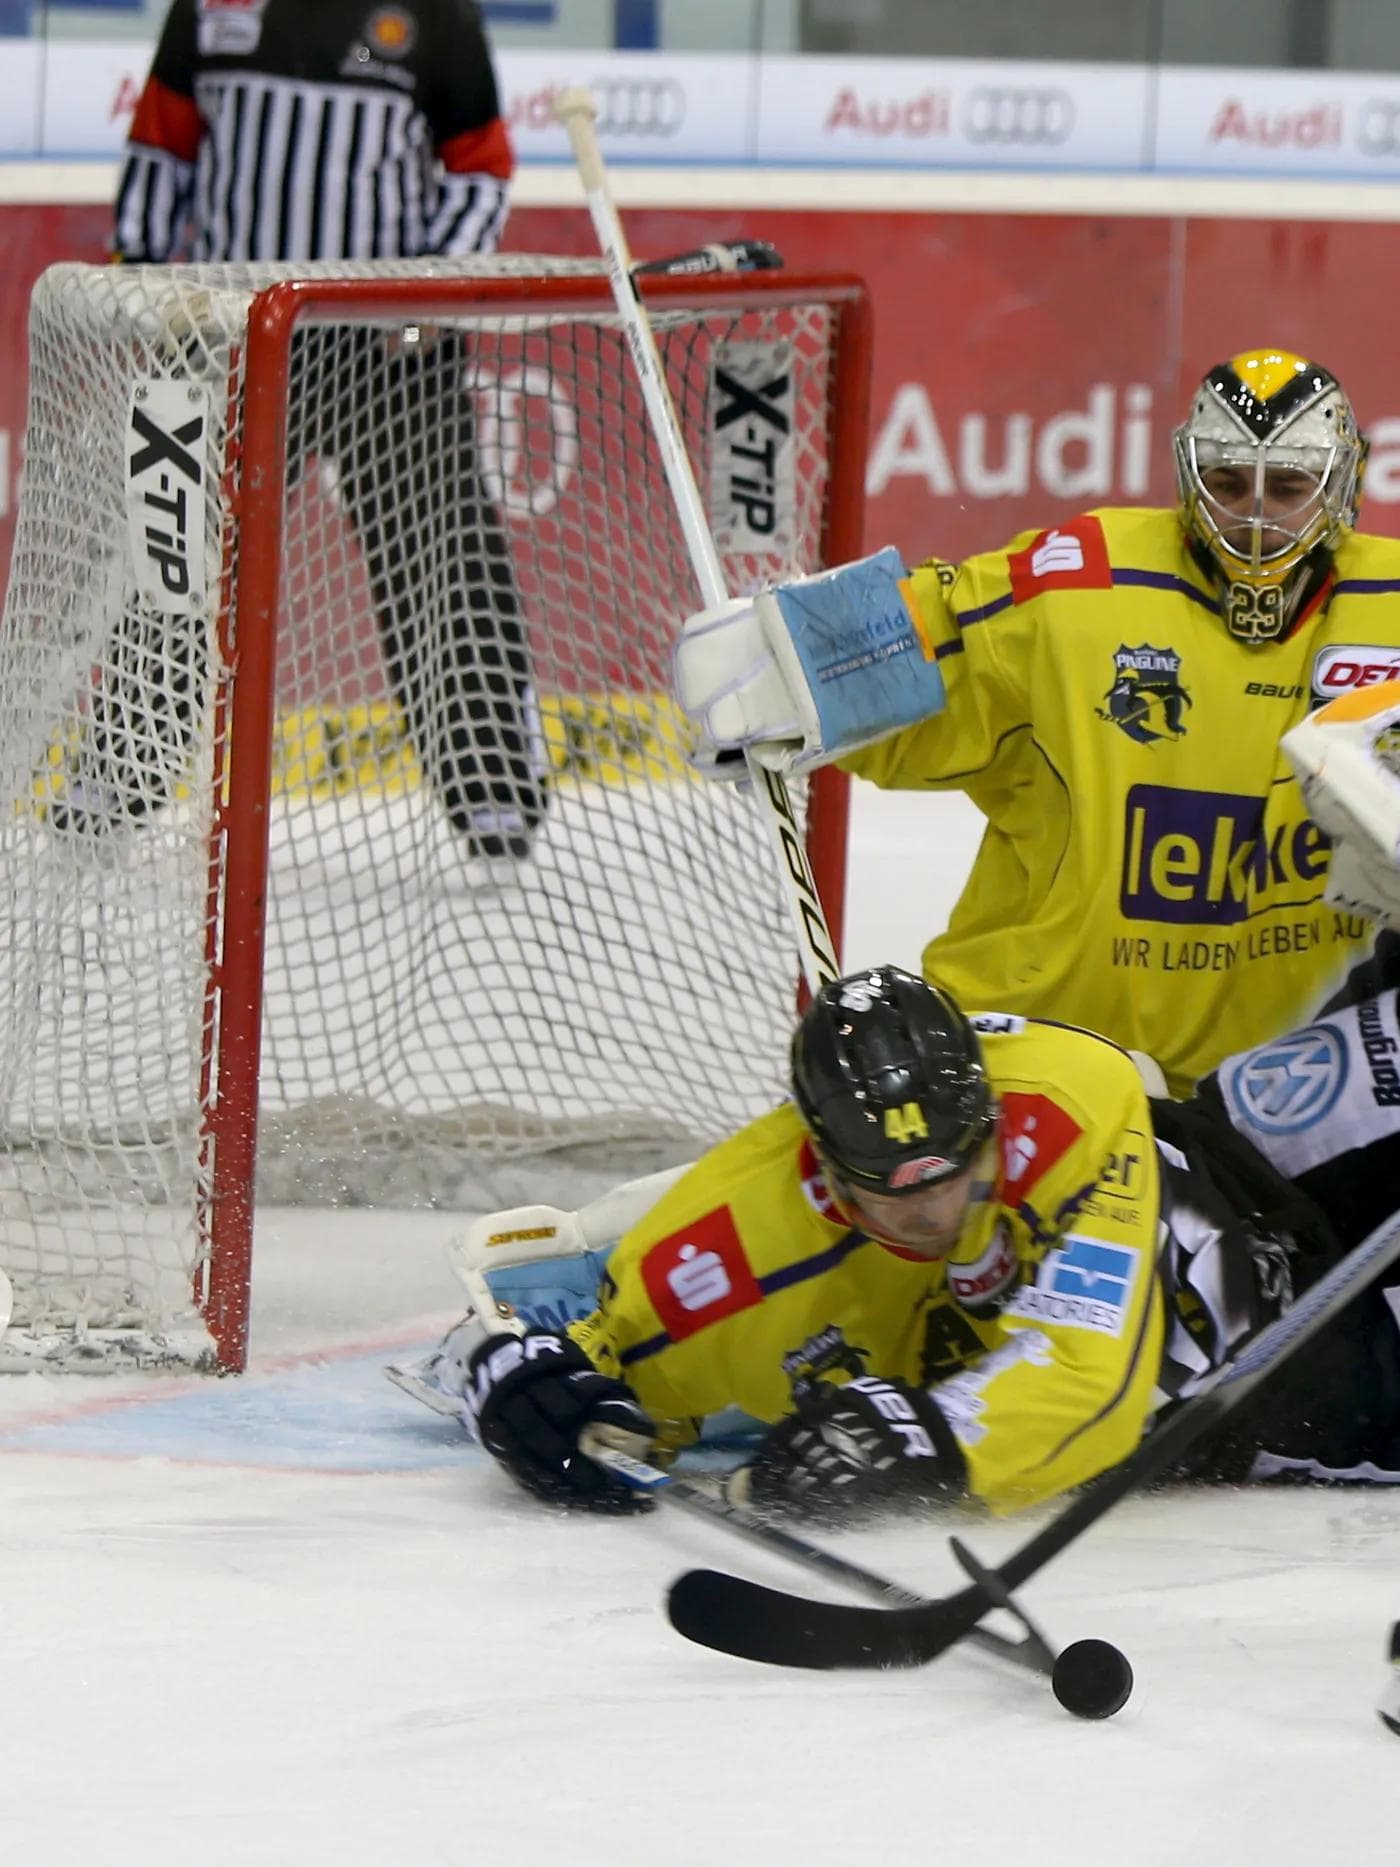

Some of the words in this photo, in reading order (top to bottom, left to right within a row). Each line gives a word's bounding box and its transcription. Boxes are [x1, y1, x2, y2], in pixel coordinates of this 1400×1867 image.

[825, 86, 951, 136] Audi
[1209, 99, 1342, 148] Audi
[865, 382, 1153, 498] Audi
[1127, 806, 1333, 904] lekke
[883, 1101, 932, 1145] 44
